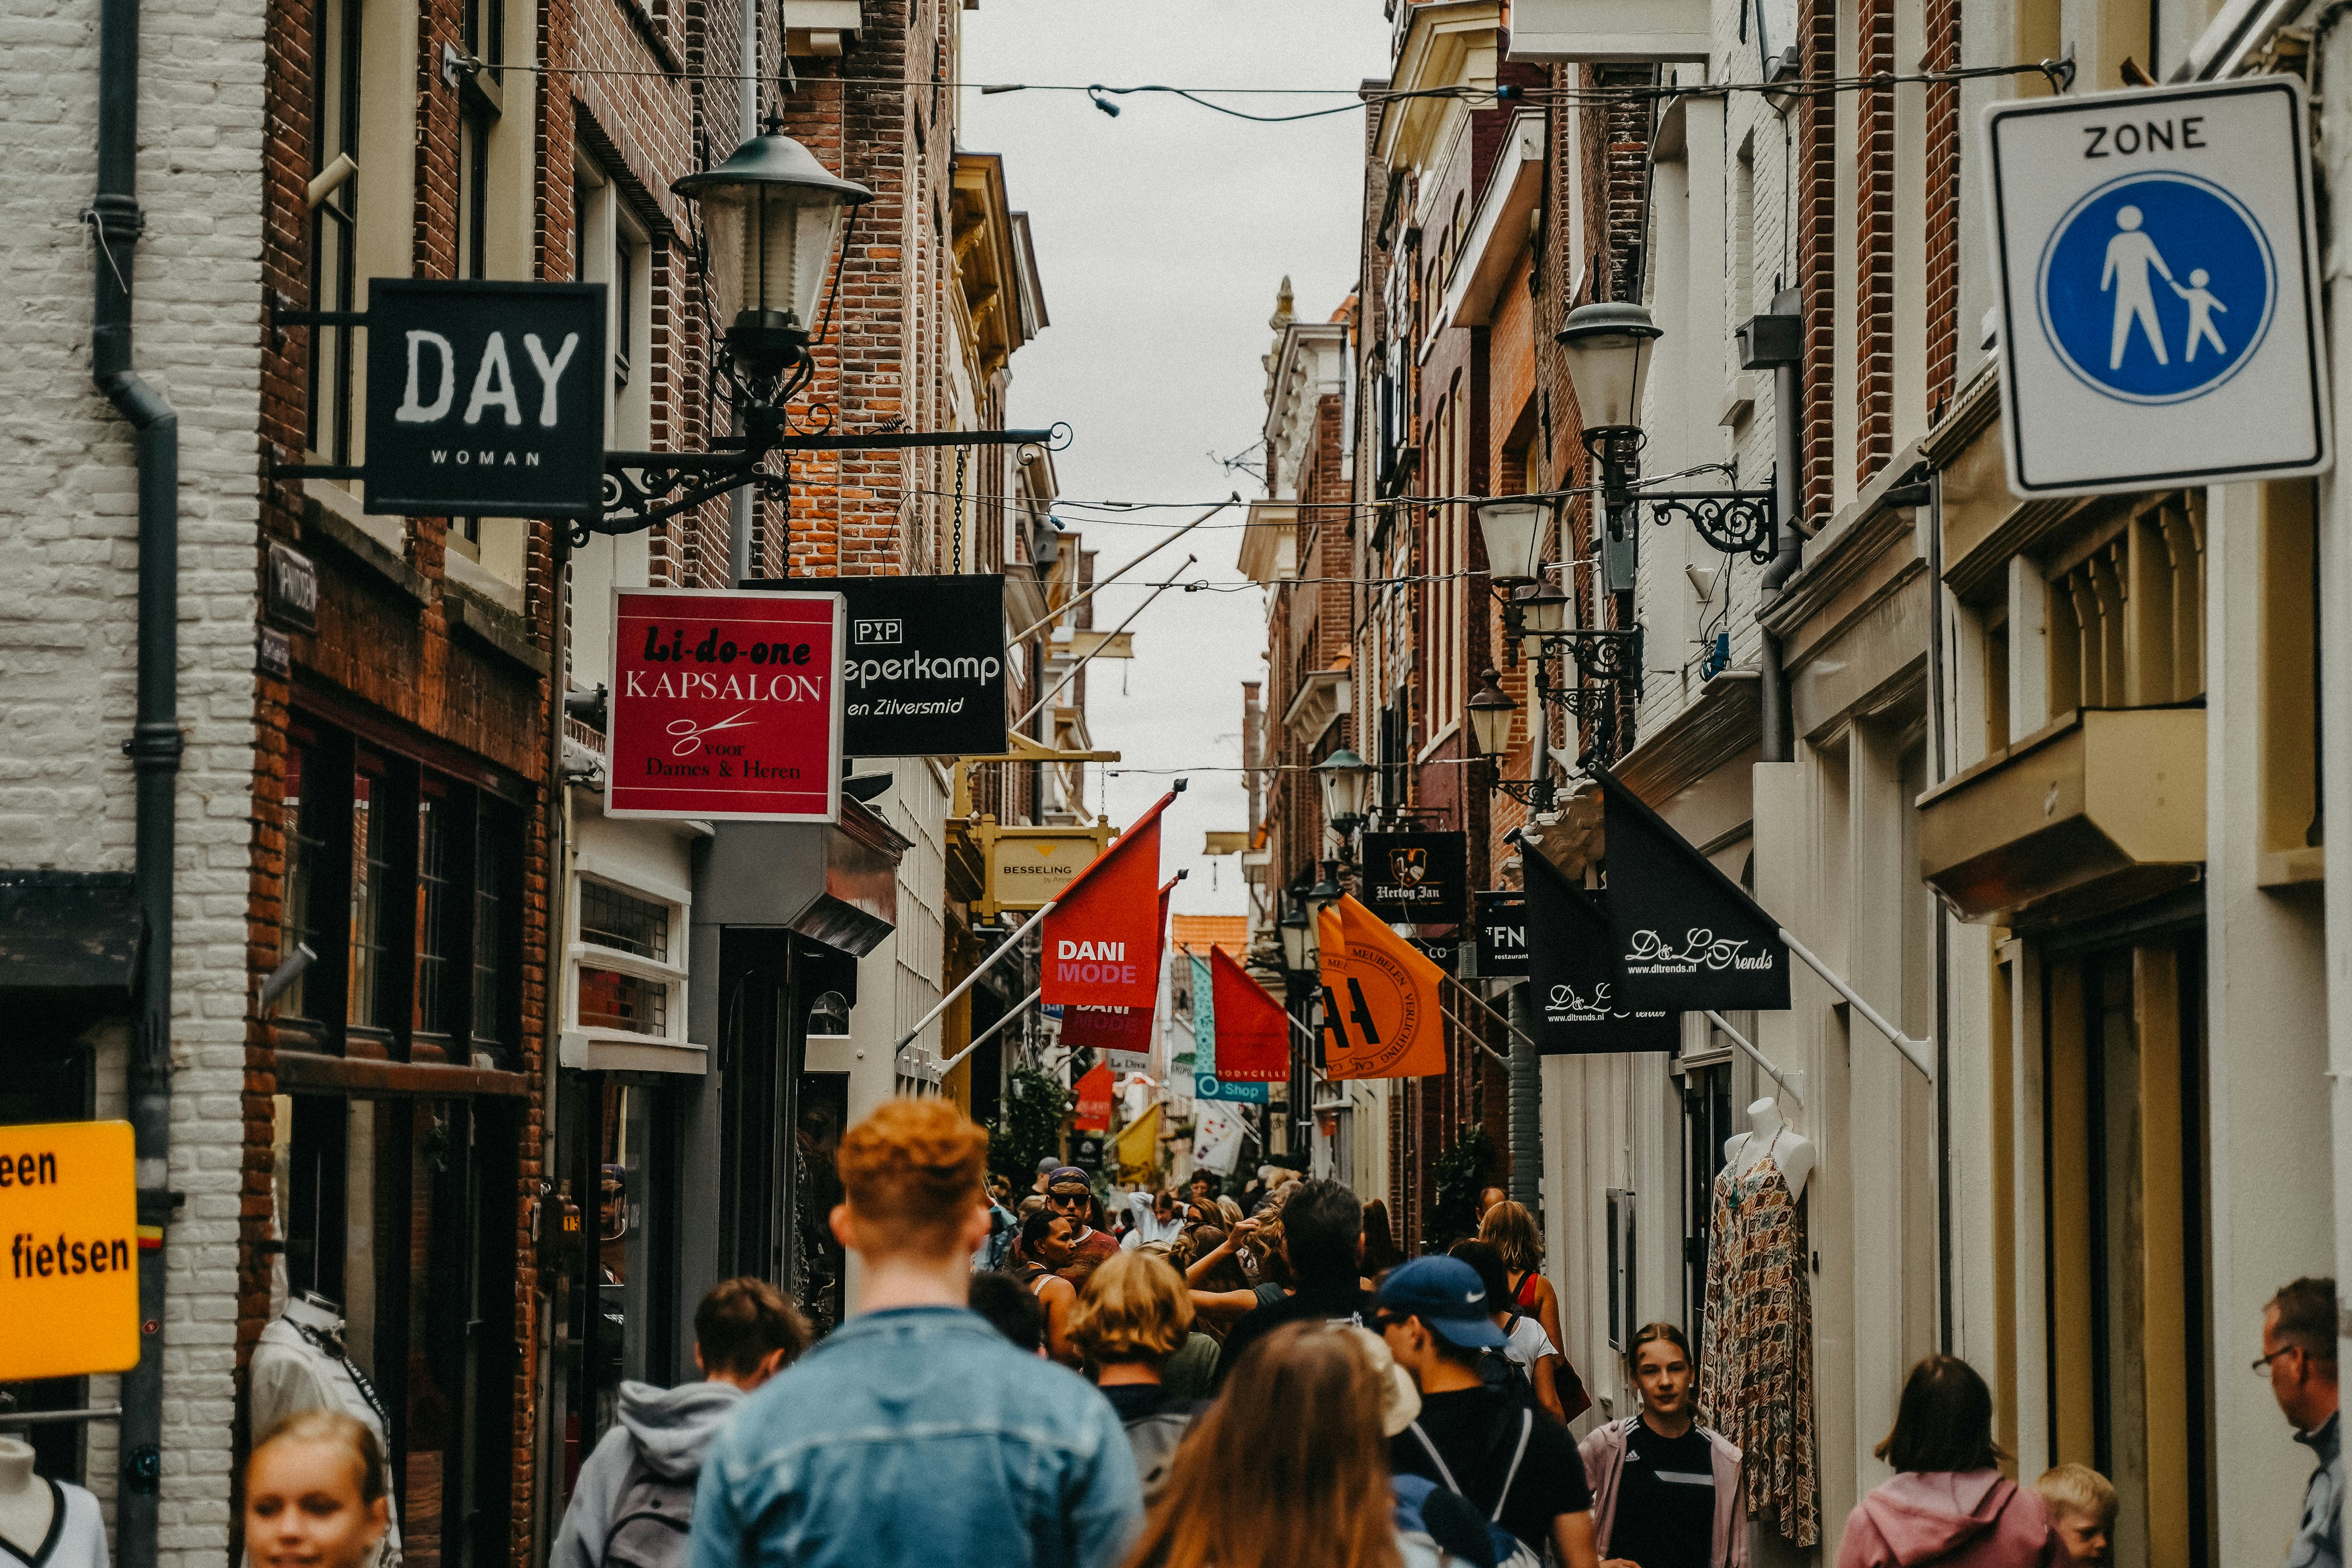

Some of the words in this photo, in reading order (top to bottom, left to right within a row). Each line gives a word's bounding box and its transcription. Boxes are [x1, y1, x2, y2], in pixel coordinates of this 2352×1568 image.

[2084, 116, 2207, 160] ZONE
[395, 329, 579, 427] DAY
[432, 450, 539, 466] WOMAN
[644, 626, 811, 666] Li-do-one
[626, 671, 823, 702] KAPSALON
[848, 704, 869, 716] en
[874, 697, 964, 716] Zilversmid
[704, 744, 745, 757] voor
[646, 758, 710, 777] Dames
[718, 760, 733, 777] &
[743, 760, 801, 780] Heren
[1376, 886, 1415, 902] Hertog
[1058, 940, 1125, 962] DANI
[1057, 963, 1136, 984] MODE
[1352, 948, 1408, 987] MEUBELEN
[1628, 964, 1697, 974] www.dltrends.nl
[1548, 1012, 1604, 1022] www.dltrends.nl
[1225, 1083, 1259, 1098] Shop
[12, 1234, 129, 1278] fietsen
